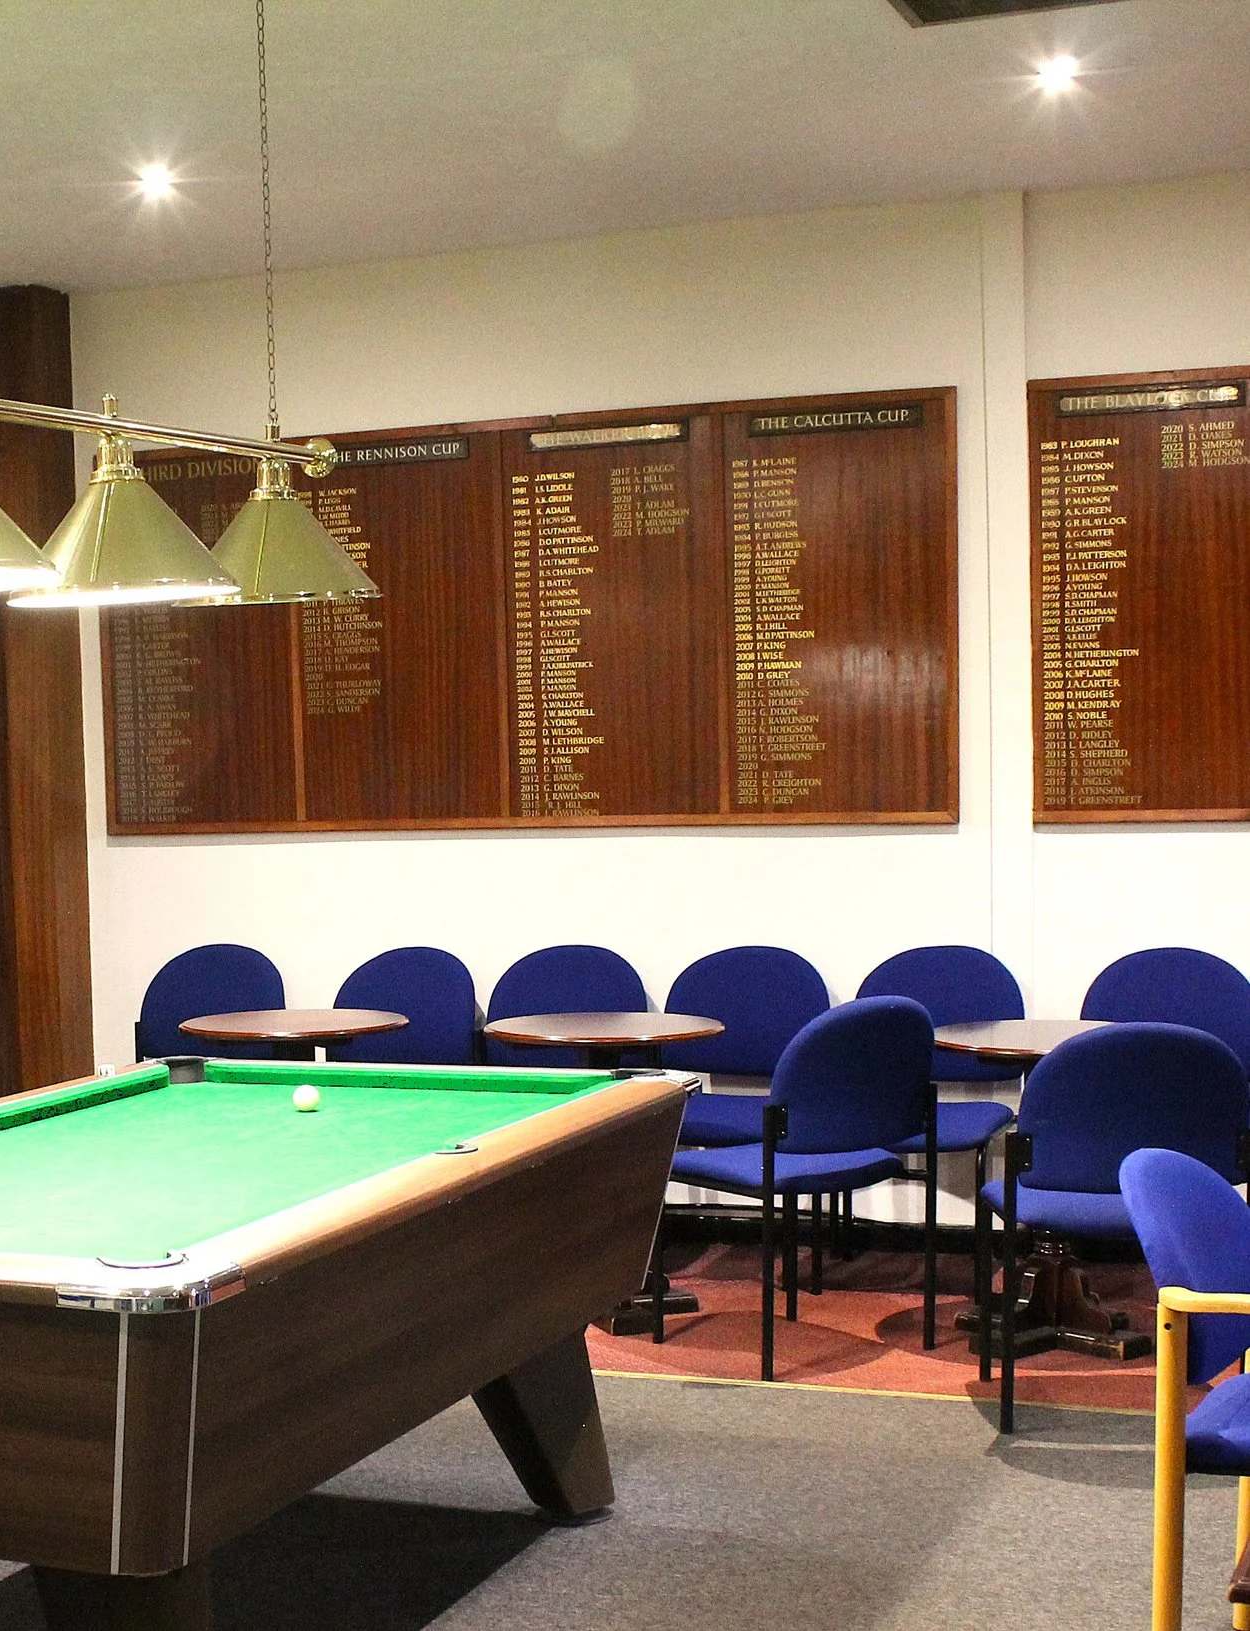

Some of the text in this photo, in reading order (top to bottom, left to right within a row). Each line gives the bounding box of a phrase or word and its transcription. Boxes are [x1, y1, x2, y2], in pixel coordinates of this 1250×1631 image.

[1068, 398, 1098, 410] THE
[1105, 392, 1191, 408] BLAYLOCK
[758, 416, 788, 430] THE
[794, 411, 873, 428] CALCUTTA
[1161, 424, 1183, 433] 2020
[1200, 421, 1234, 430] AHMED
[1161, 443, 1183, 451] 2022
[1202, 440, 1244, 449] SIMPSON
[357, 445, 427, 461] RENNISON
[432, 443, 460, 455] CUP
[736, 643, 753, 651] 2007
[736, 663, 754, 671] 2009
[1044, 681, 1063, 689] 2007
[518, 702, 535, 710] 2004
[518, 719, 536, 727] 2006
[769, 716, 819, 725] RAWLINSON
[553, 737, 604, 745] LETHBRIDGE
[1045, 741, 1066, 749] 2013
[1079, 740, 1120, 748] LANGLEY
[772, 753, 812, 761] SIMMONS
[1080, 749, 1128, 757] SHEPHERD
[554, 783, 579, 791] DIXON
